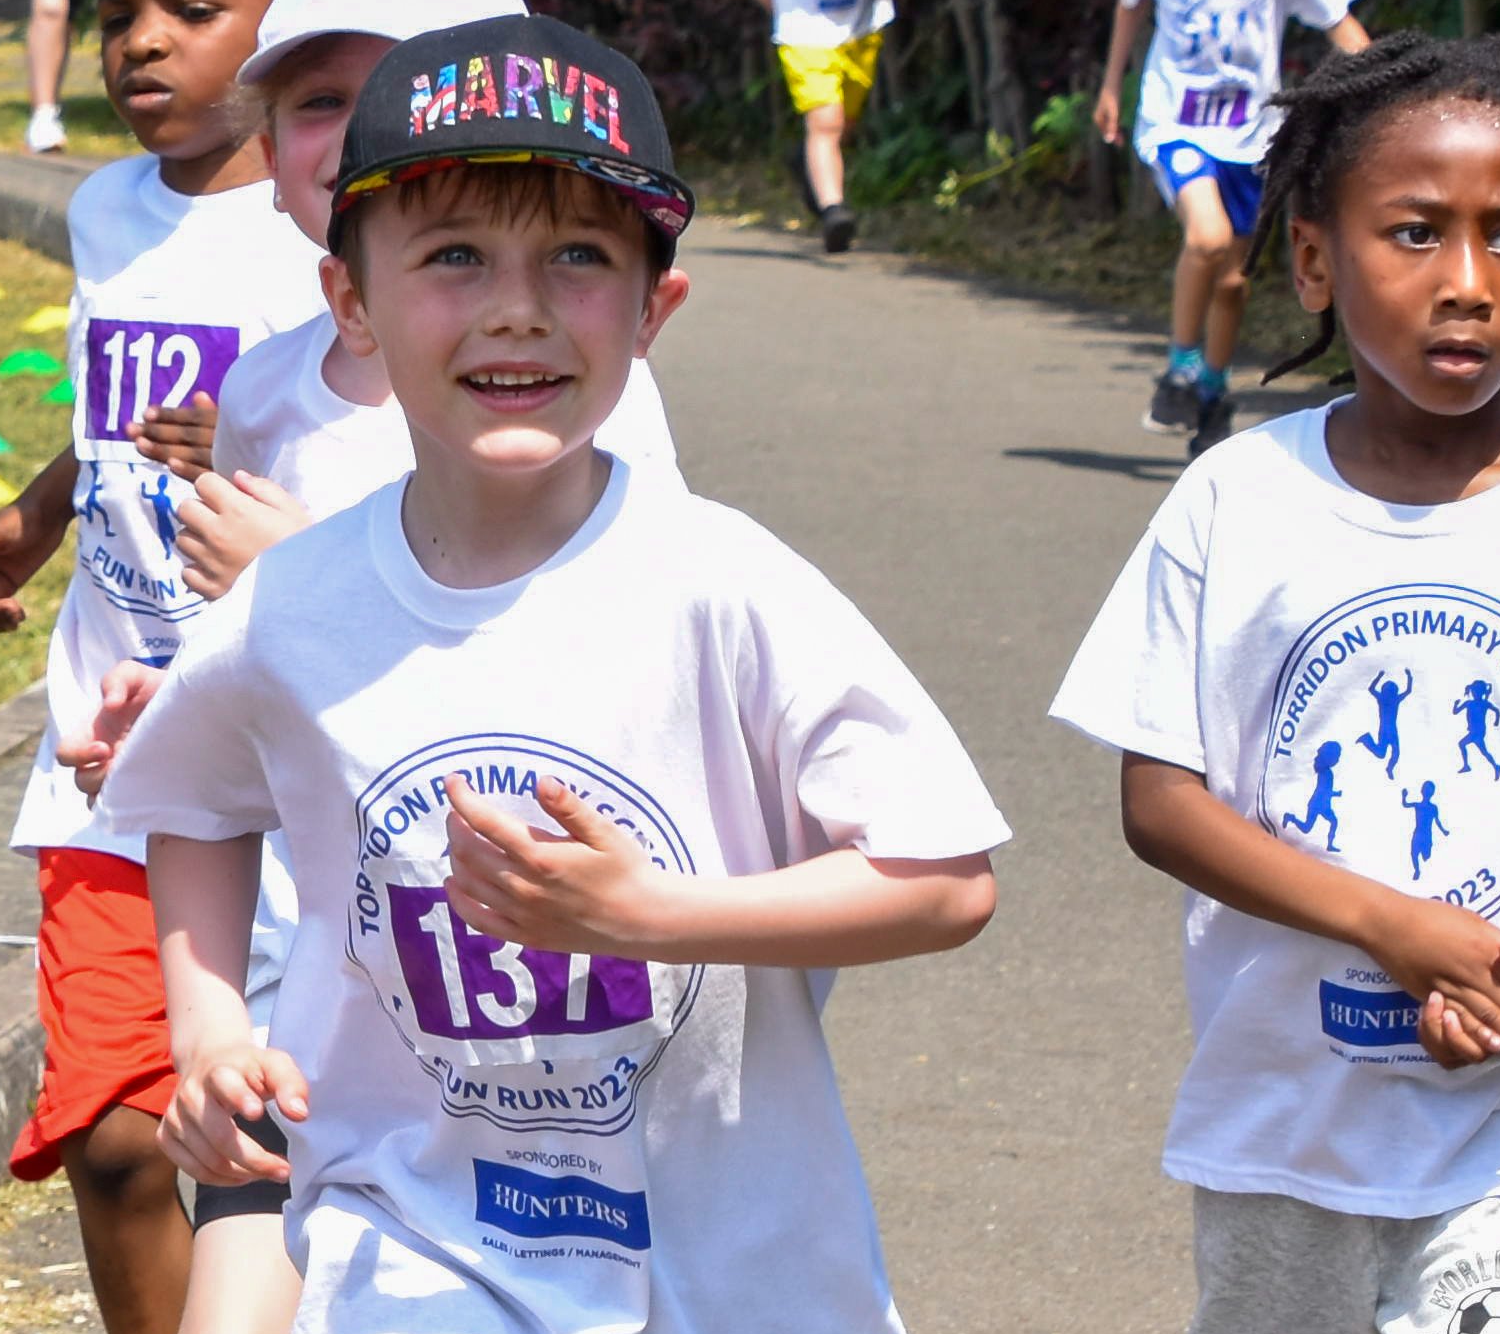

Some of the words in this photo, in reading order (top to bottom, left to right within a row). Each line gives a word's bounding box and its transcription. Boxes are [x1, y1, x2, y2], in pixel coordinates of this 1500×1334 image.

[408, 53, 631, 156] MARVEL
[104, 330, 201, 432] 112
[93, 545, 134, 589] FUN
[1274, 625, 1368, 758] TORRIDON
[1430, 868, 1496, 907] 023
[1330, 1002, 1419, 1029] HUNTE
[497, 1085, 571, 1111] RUN
[572, 1056, 638, 1110] 2023
[506, 1150, 587, 1169] SPONSORED
[589, 1160, 602, 1175] BY
[494, 1183, 629, 1230] HUNTERS
[482, 1237, 508, 1255] SALES
[514, 1247, 565, 1259] LETTINGS
[576, 1248, 641, 1268] MANAGEMENT
